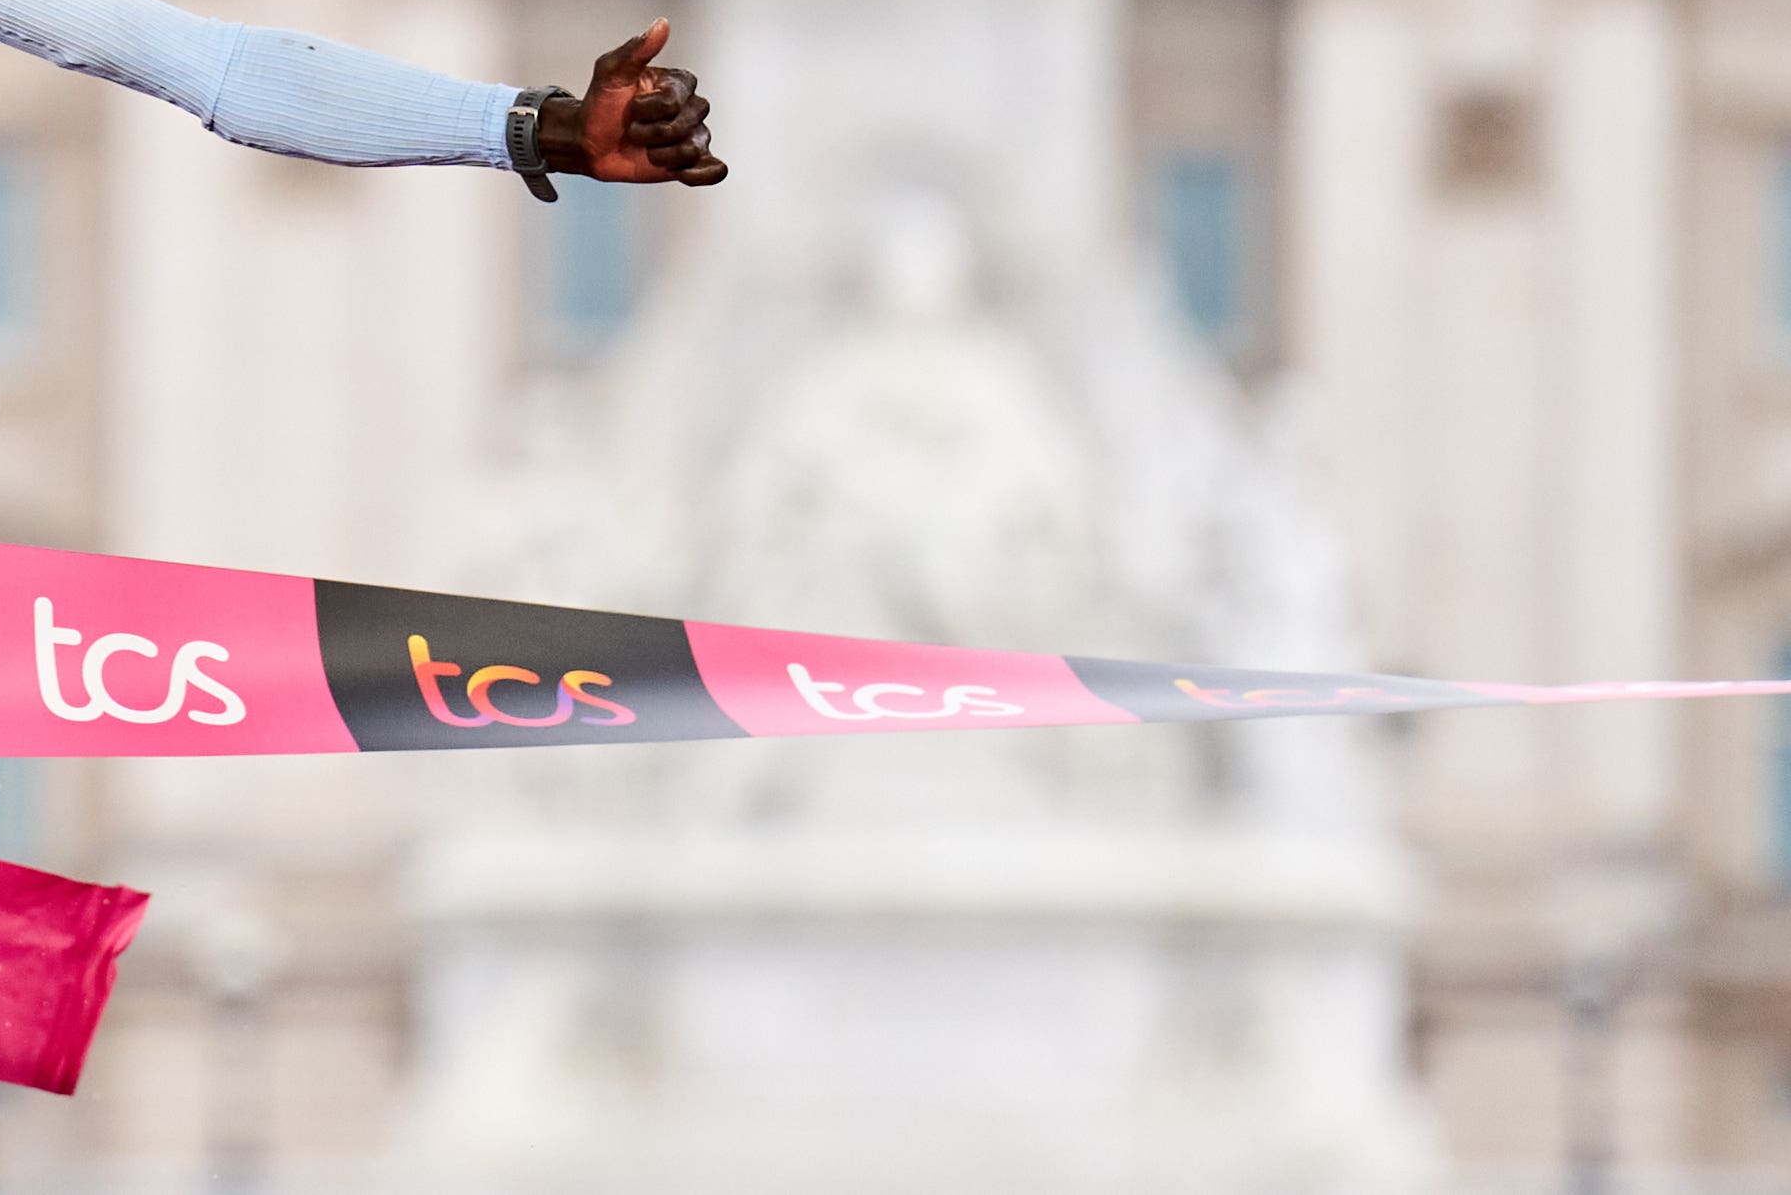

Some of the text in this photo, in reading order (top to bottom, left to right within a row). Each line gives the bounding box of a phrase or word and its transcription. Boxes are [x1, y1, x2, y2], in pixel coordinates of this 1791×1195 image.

[34, 596, 246, 726] tcs
[408, 634, 637, 727] tcs
[788, 662, 1024, 721] tcs
